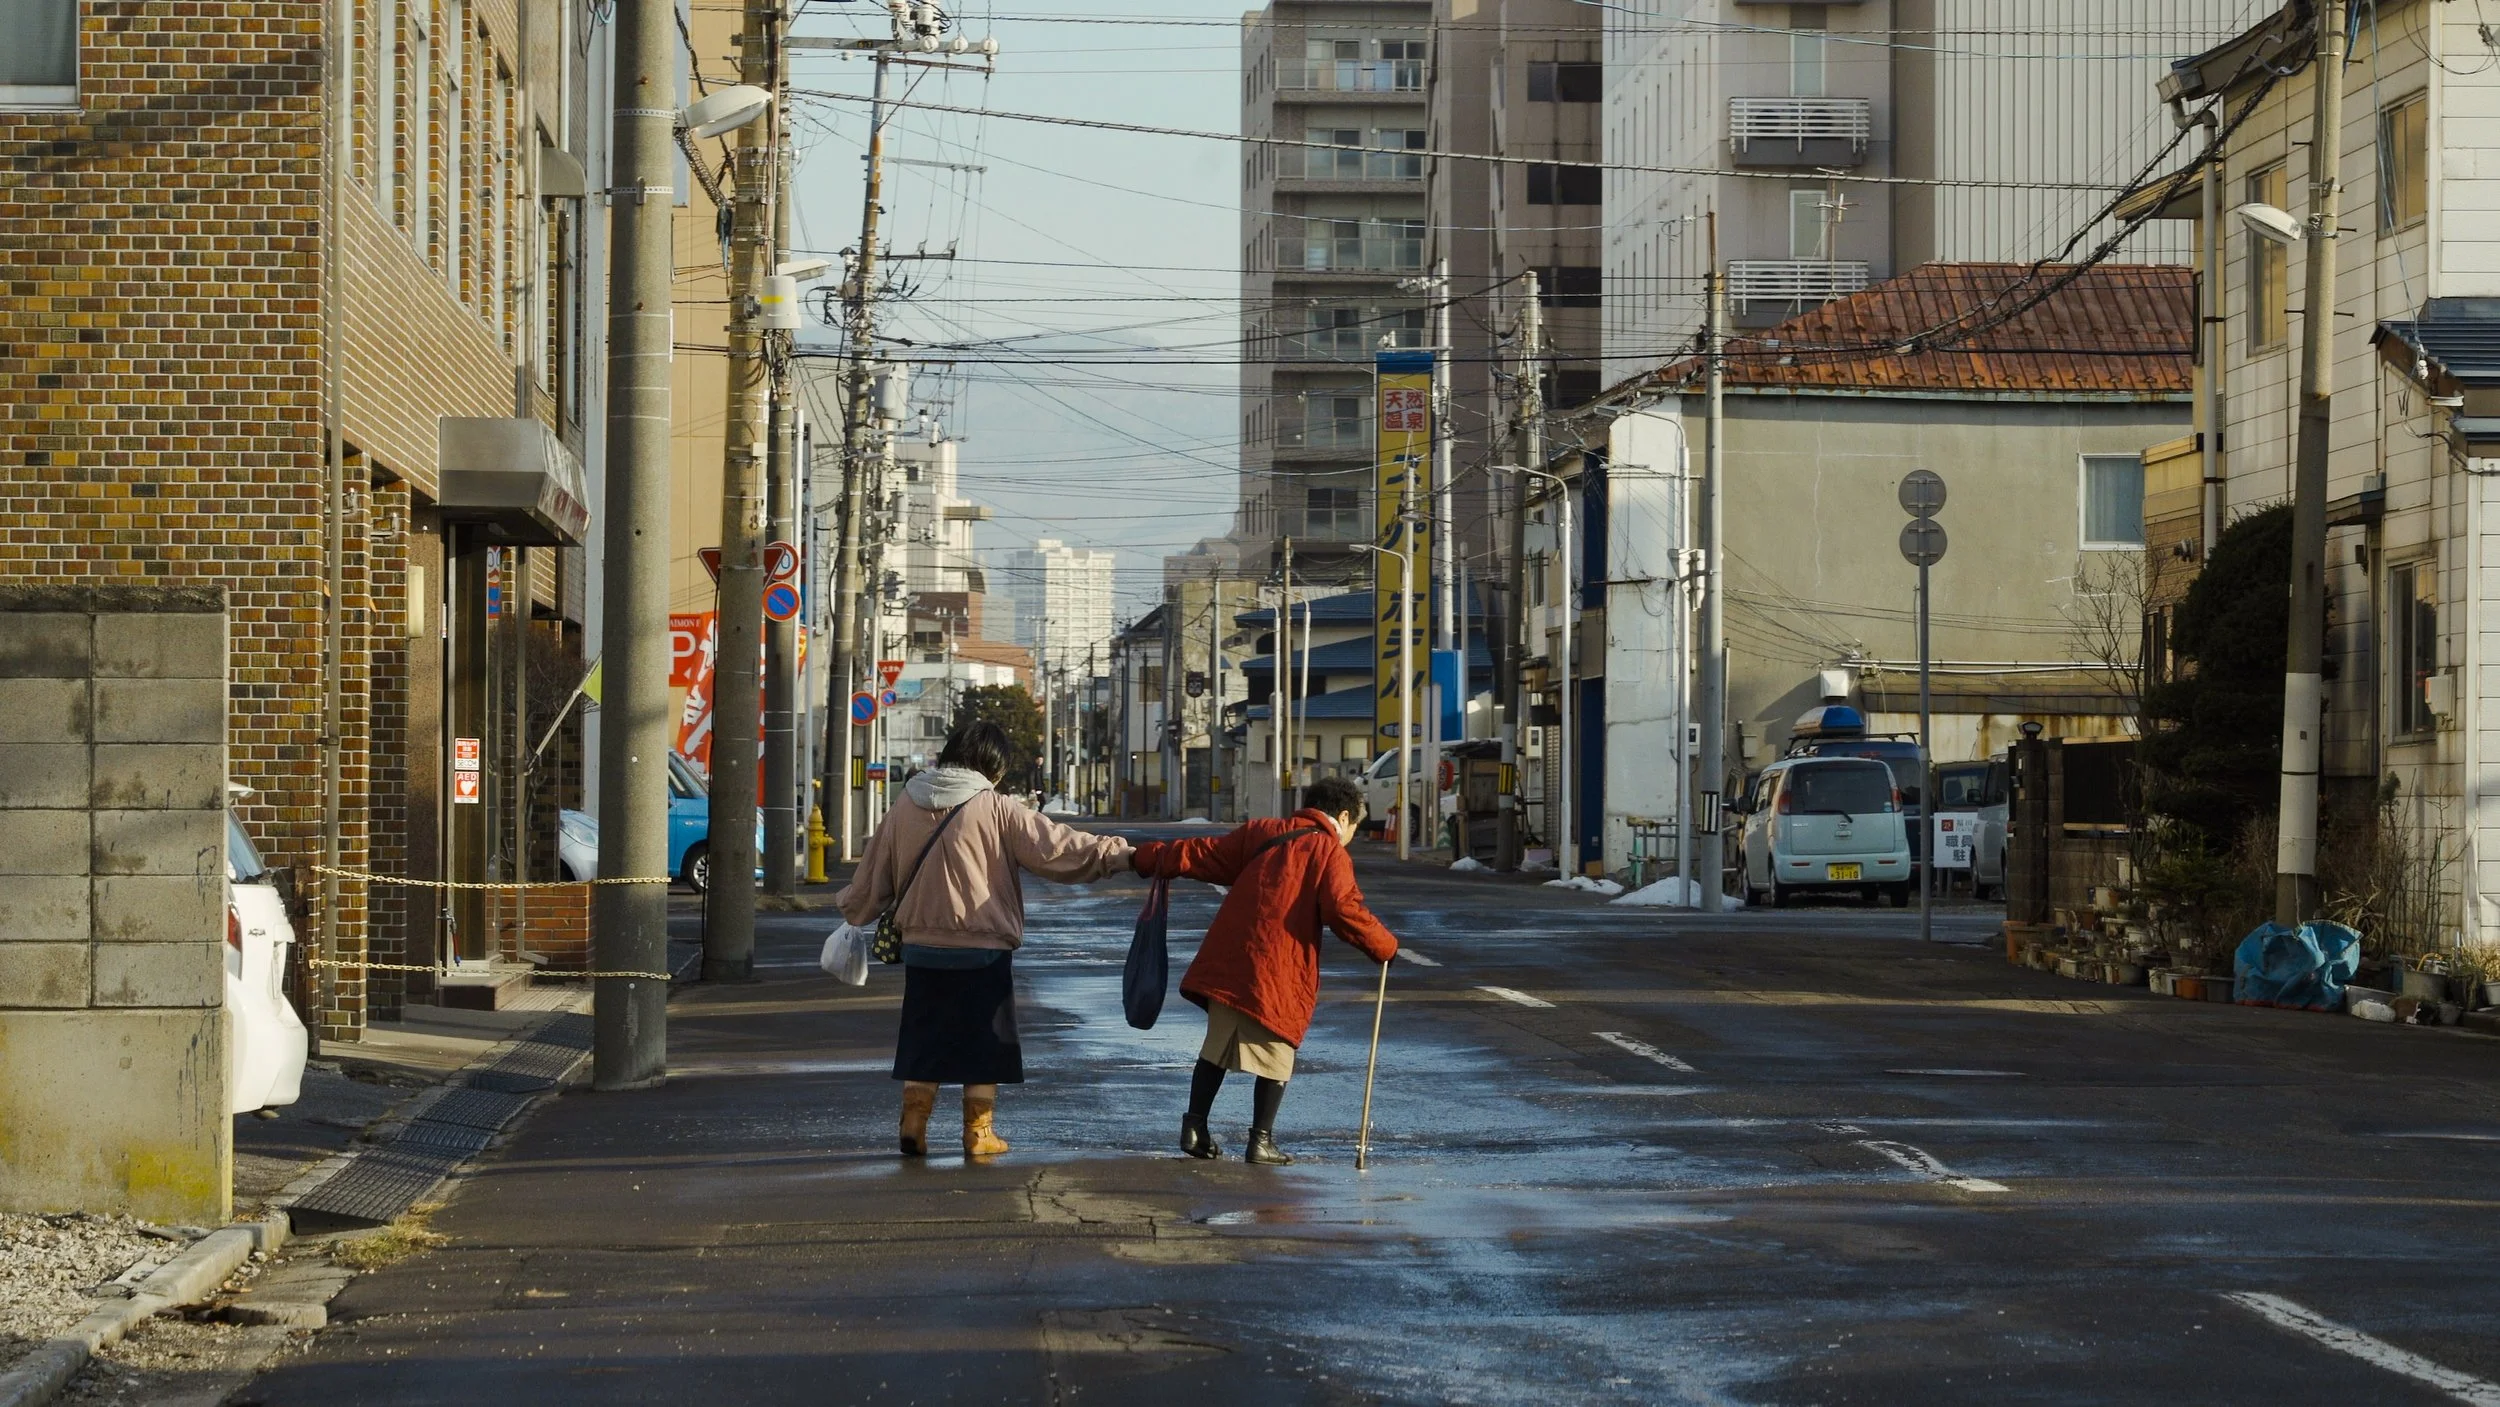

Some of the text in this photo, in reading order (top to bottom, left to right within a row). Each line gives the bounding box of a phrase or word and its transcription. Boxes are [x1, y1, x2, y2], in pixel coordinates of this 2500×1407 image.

[1386, 391, 1422, 408] 天然
[1386, 411, 1422, 429] 温泉
[1379, 454, 1427, 699] スパホテル
[670, 619, 694, 627] AIMON
[669, 631, 696, 674] P
[1945, 834, 1973, 848] 職員
